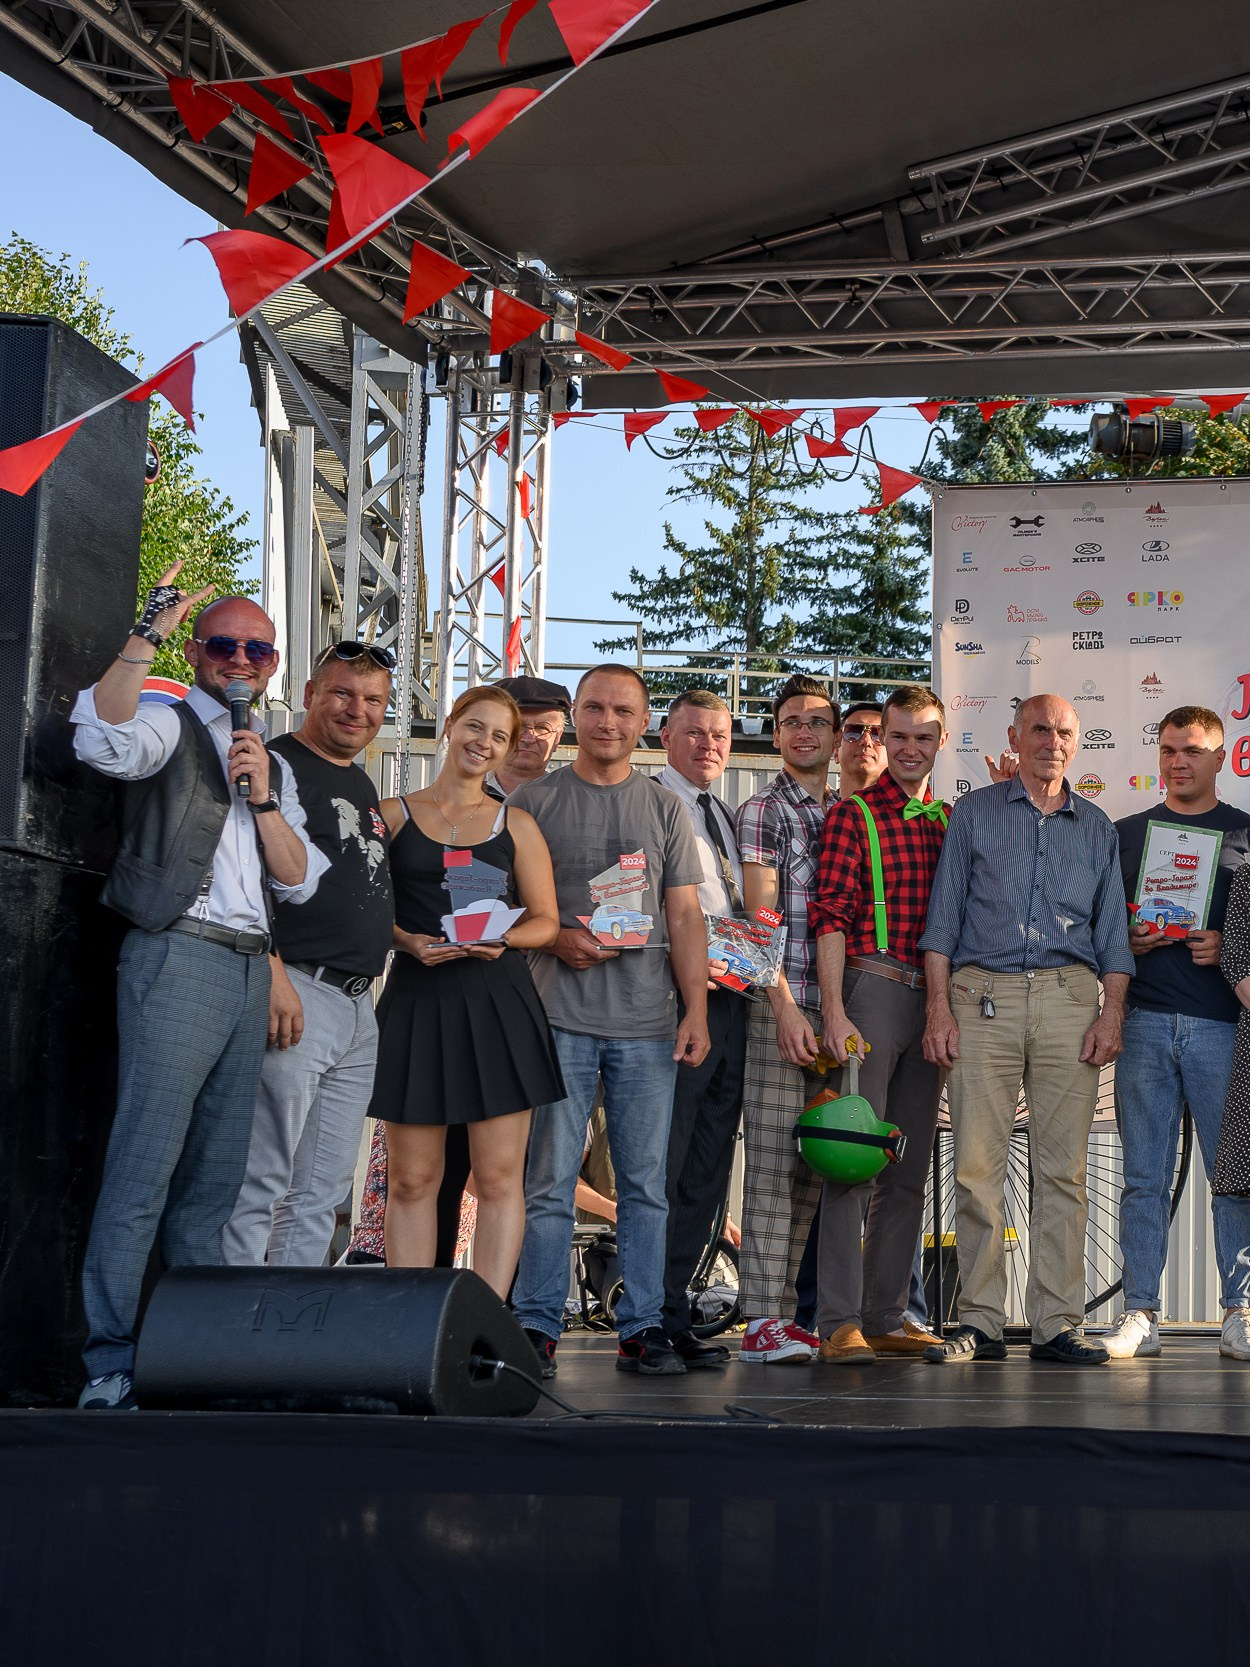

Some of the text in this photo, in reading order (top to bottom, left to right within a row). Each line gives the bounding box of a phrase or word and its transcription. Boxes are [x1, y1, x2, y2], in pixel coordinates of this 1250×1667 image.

[951, 515, 988, 533] Victory
[1141, 554, 1170, 562] LADA
[1127, 590, 1185, 607] ЯРКО
[1072, 631, 1104, 641] РЕТРО
[951, 695, 988, 714] Victory
[622, 857, 645, 866] 2024
[1175, 857, 1197, 866] 2024
[759, 909, 780, 925] 2024
